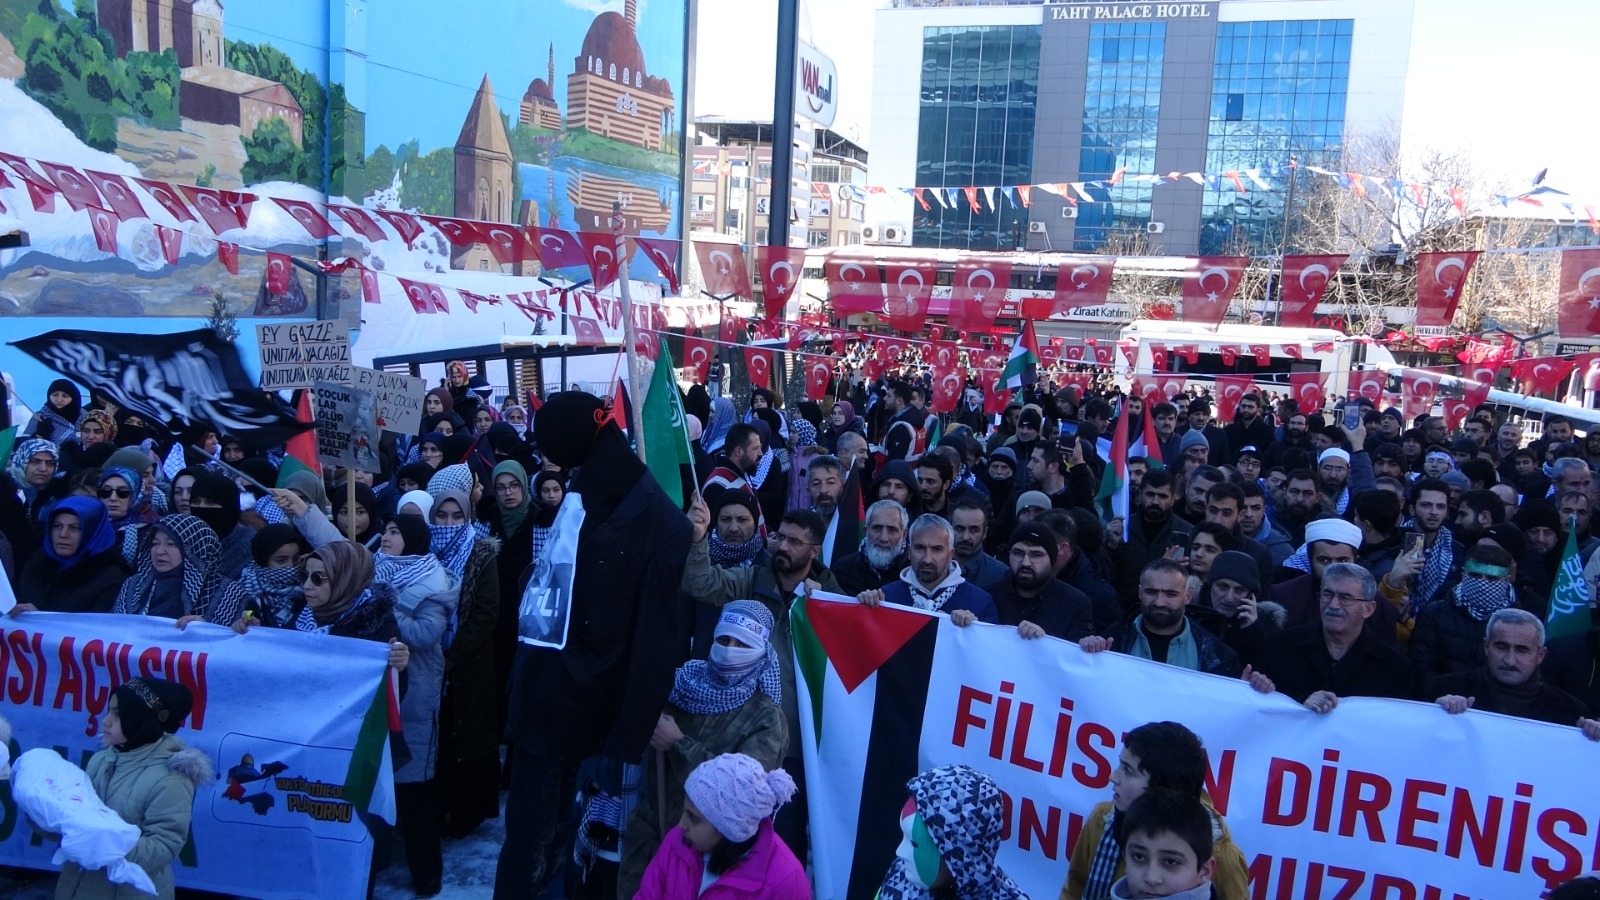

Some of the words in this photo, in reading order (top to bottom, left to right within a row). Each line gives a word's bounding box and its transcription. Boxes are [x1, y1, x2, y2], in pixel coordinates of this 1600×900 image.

[1051, 6, 1091, 20] TAHT
[1093, 5, 1152, 19] PALACE
[1156, 4, 1211, 18] HOTEL
[1073, 307, 1099, 317] Ziraat
[261, 325, 281, 344] EY
[318, 388, 351, 403] ÇOCUK
[318, 399, 337, 411] LAR
[318, 408, 344, 423] ÖLÜR
[319, 437, 349, 450] KALIN
[319, 447, 341, 458] MAZ
[275, 777, 293, 791] VAN
[952, 681, 1236, 817] FİLİSN
[1261, 748, 1600, 900] DİRENİŞ
